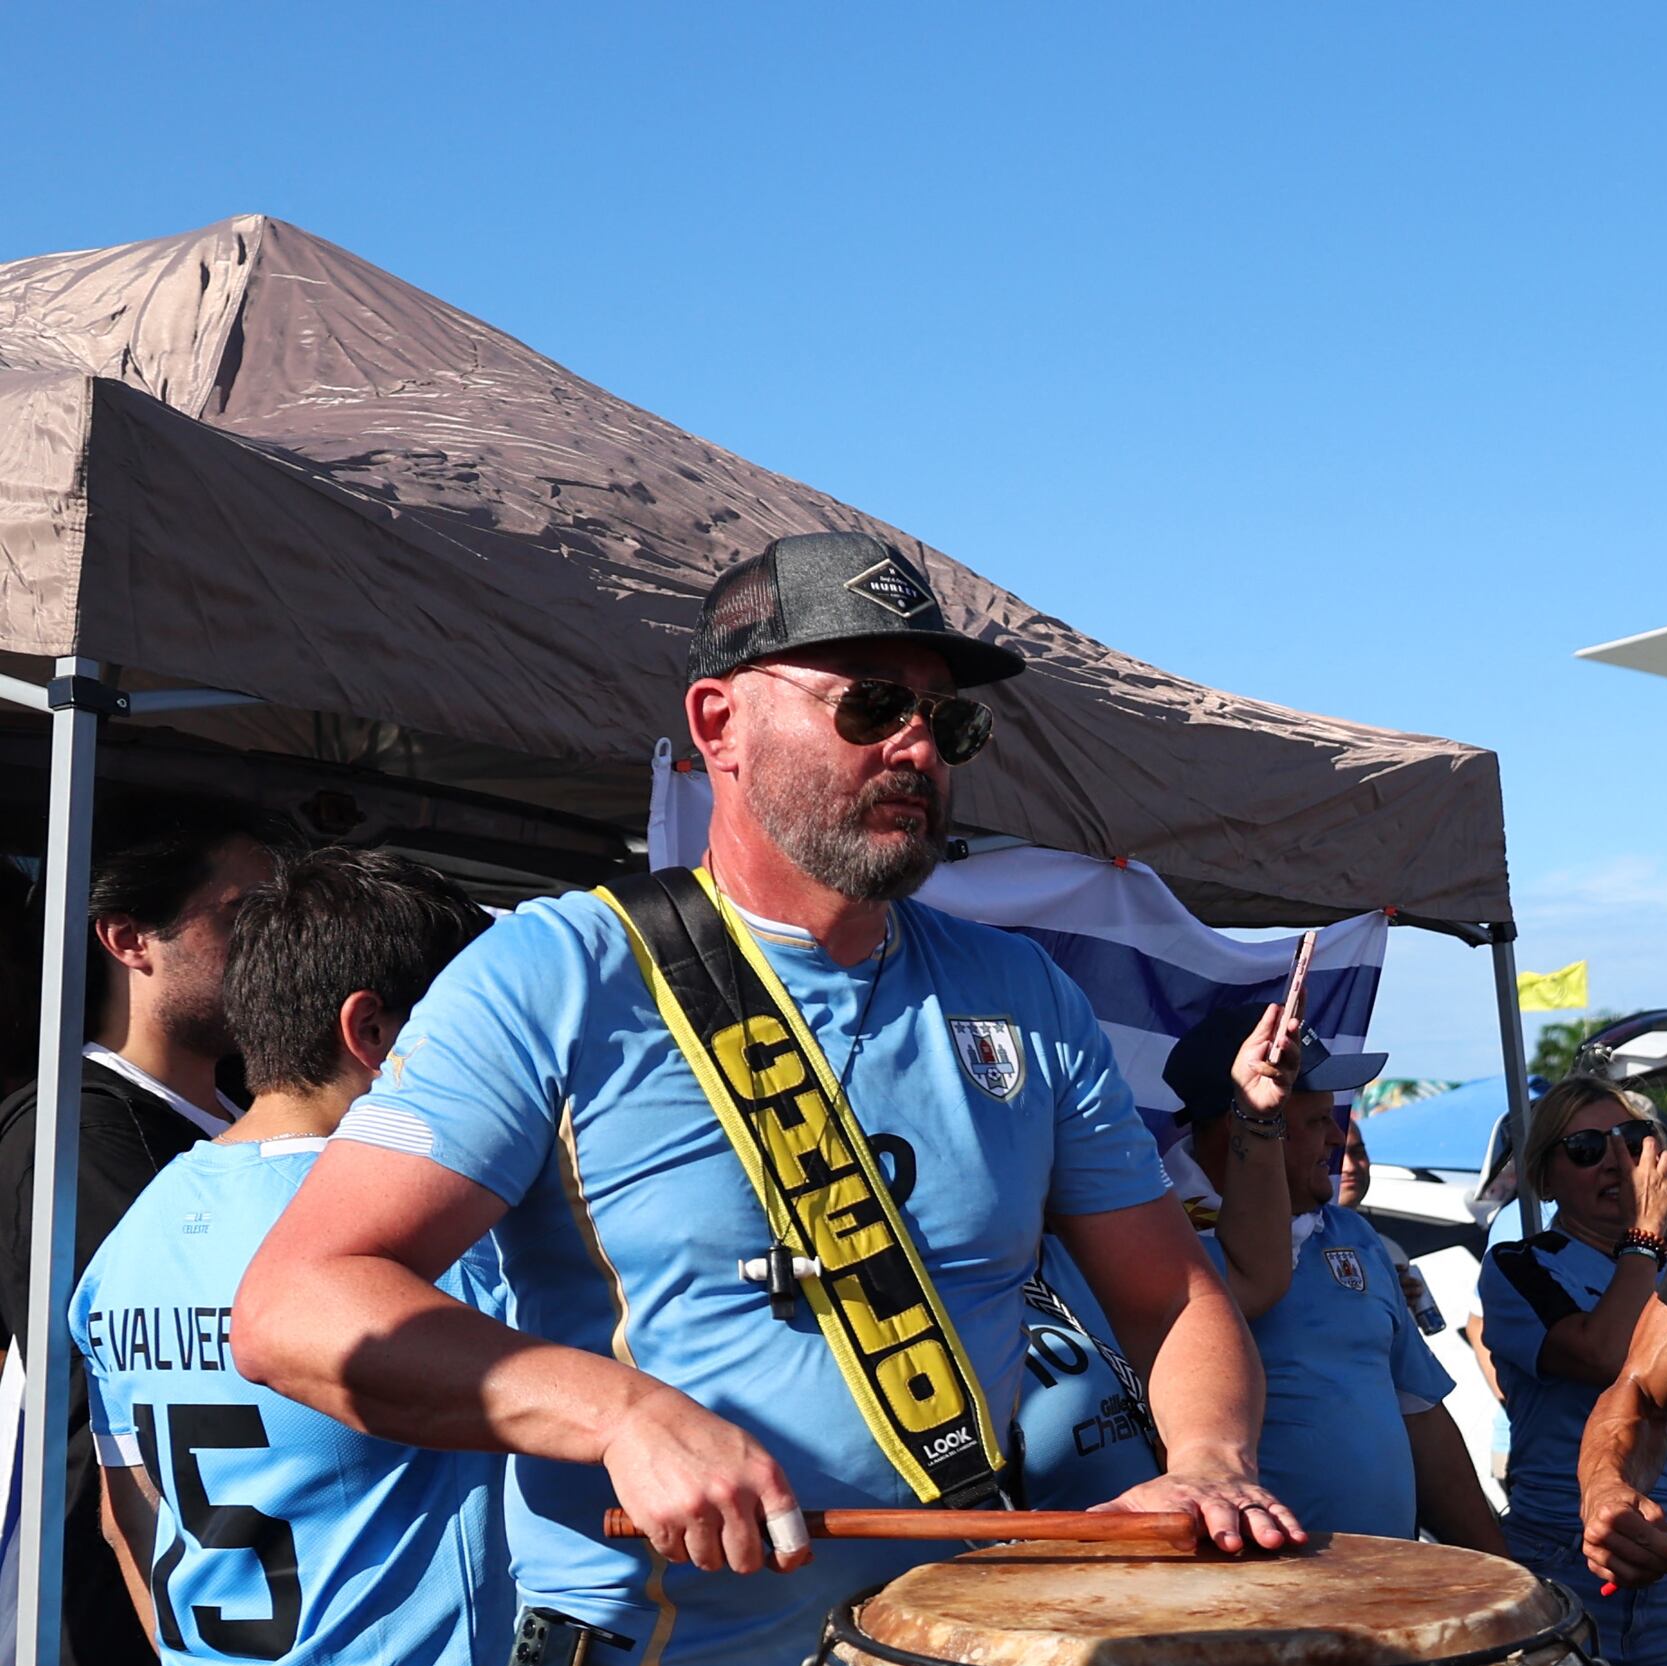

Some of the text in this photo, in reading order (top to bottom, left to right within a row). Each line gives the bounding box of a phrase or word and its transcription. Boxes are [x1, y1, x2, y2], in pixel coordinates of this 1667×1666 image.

[711, 1012, 965, 1432] CHELO
[132, 1403, 303, 1662] 15
[923, 1426, 972, 1459] LOOK
